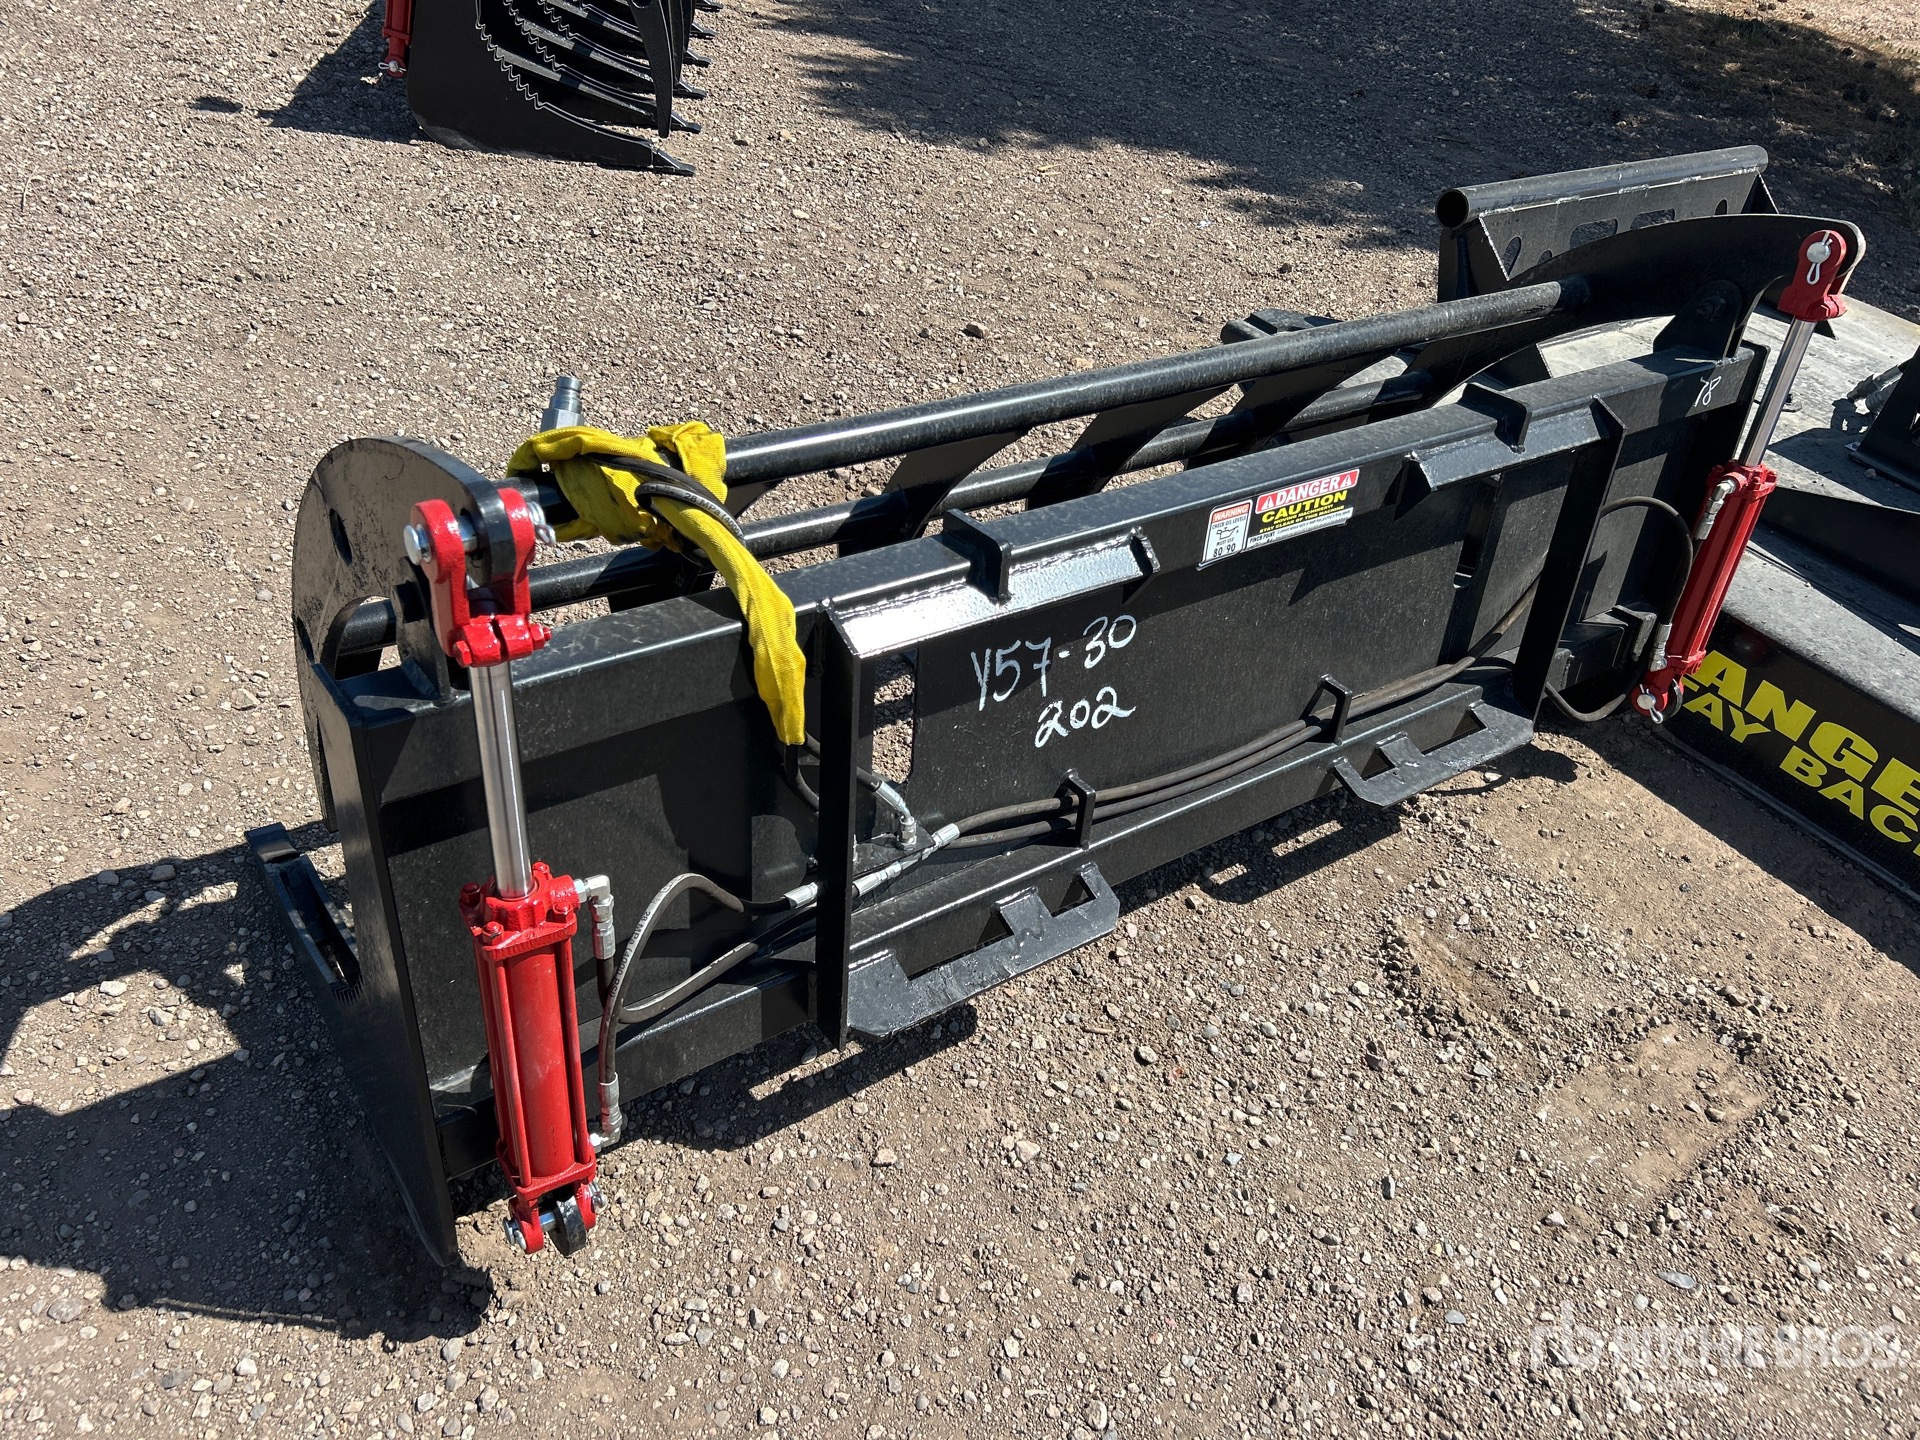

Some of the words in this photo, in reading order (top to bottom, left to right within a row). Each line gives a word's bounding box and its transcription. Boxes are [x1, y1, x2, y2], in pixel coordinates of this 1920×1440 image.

[684, 492, 698, 503] 28
[1275, 476, 1340, 506] DANGER
[1214, 506, 1248, 521] WARNING
[1259, 525, 1275, 534] STAY
[1276, 520, 1295, 529] CLEAR
[1318, 505, 1345, 517] MACHINE
[1262, 490, 1348, 523] CAUTION
[1273, 514, 1297, 525] MOVING
[1211, 522, 1225, 531] CHECK
[1225, 519, 1233, 527] OIL
[970, 615, 1137, 711] Y57-30
[1034, 686, 1137, 748] 202
[1688, 650, 1920, 816] ANGE
[1779, 745, 1920, 857] BAC
[641, 911, 651, 921] 28
